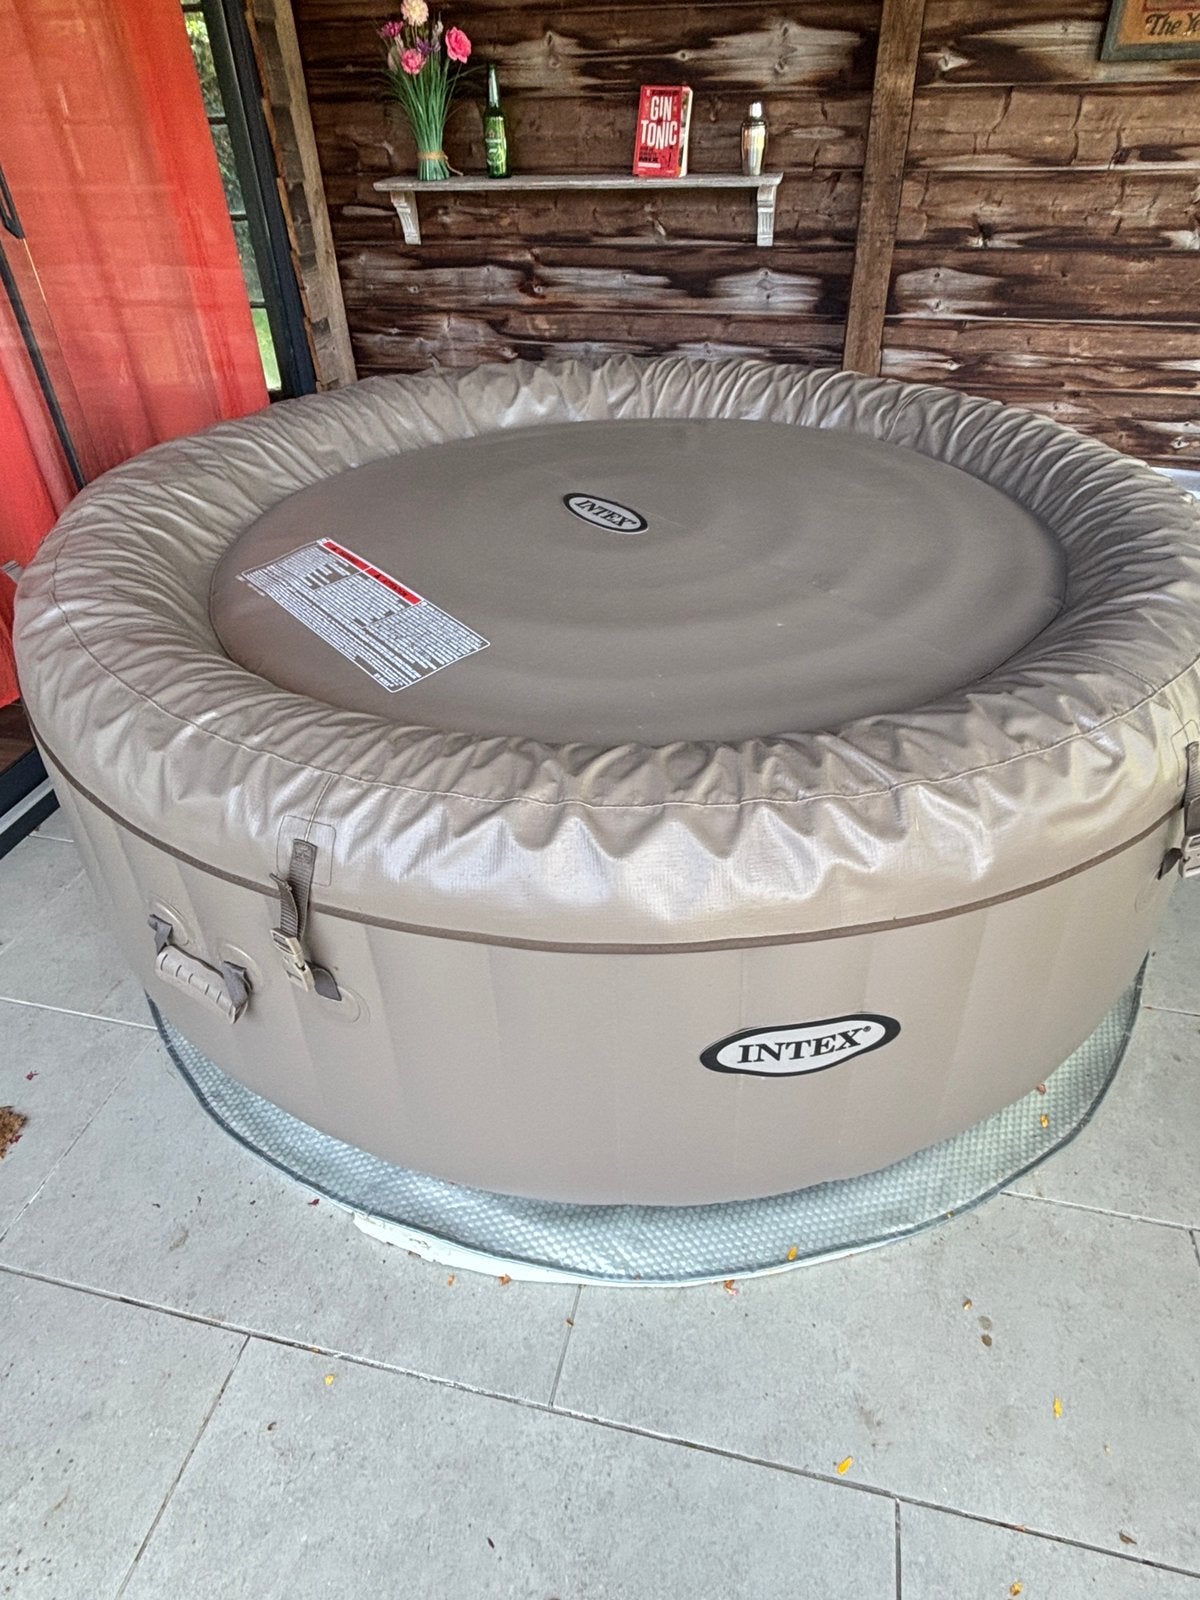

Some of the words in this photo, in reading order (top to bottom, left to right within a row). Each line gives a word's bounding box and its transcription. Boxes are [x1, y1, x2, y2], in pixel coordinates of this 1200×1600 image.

[1145, 11, 1182, 36] The
[650, 95, 673, 121] GIN
[641, 120, 678, 150] TONIC
[574, 499, 631, 527] INTEX
